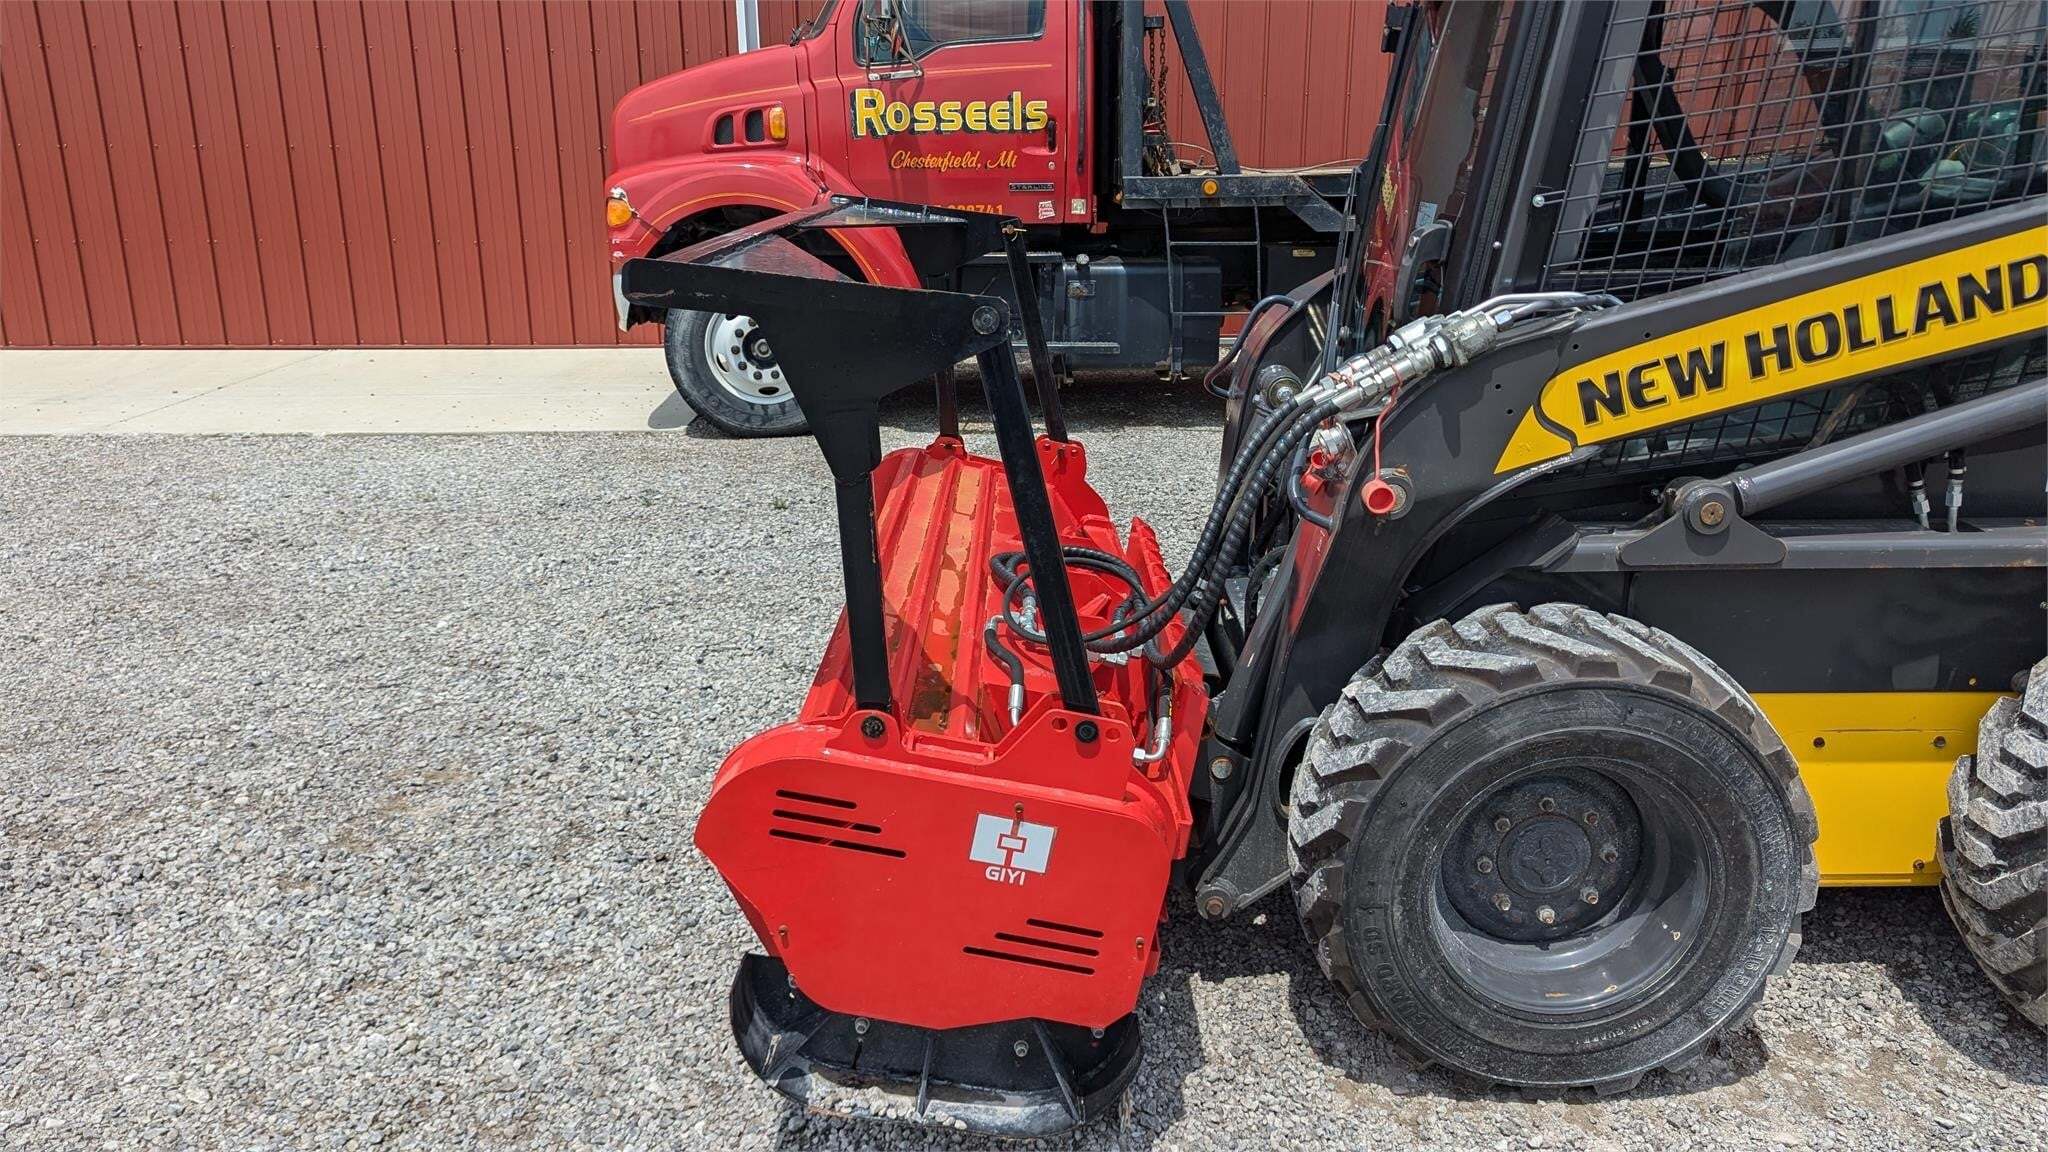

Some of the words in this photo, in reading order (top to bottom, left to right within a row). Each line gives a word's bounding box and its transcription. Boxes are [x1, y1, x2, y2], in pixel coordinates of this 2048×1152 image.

[853, 88, 1048, 137] Rosseels
[891, 150, 981, 172] Chesterfield,
[1576, 340, 1726, 425] NEW
[1744, 253, 2048, 380] HOLLAND
[986, 866, 1025, 886] GIYI
